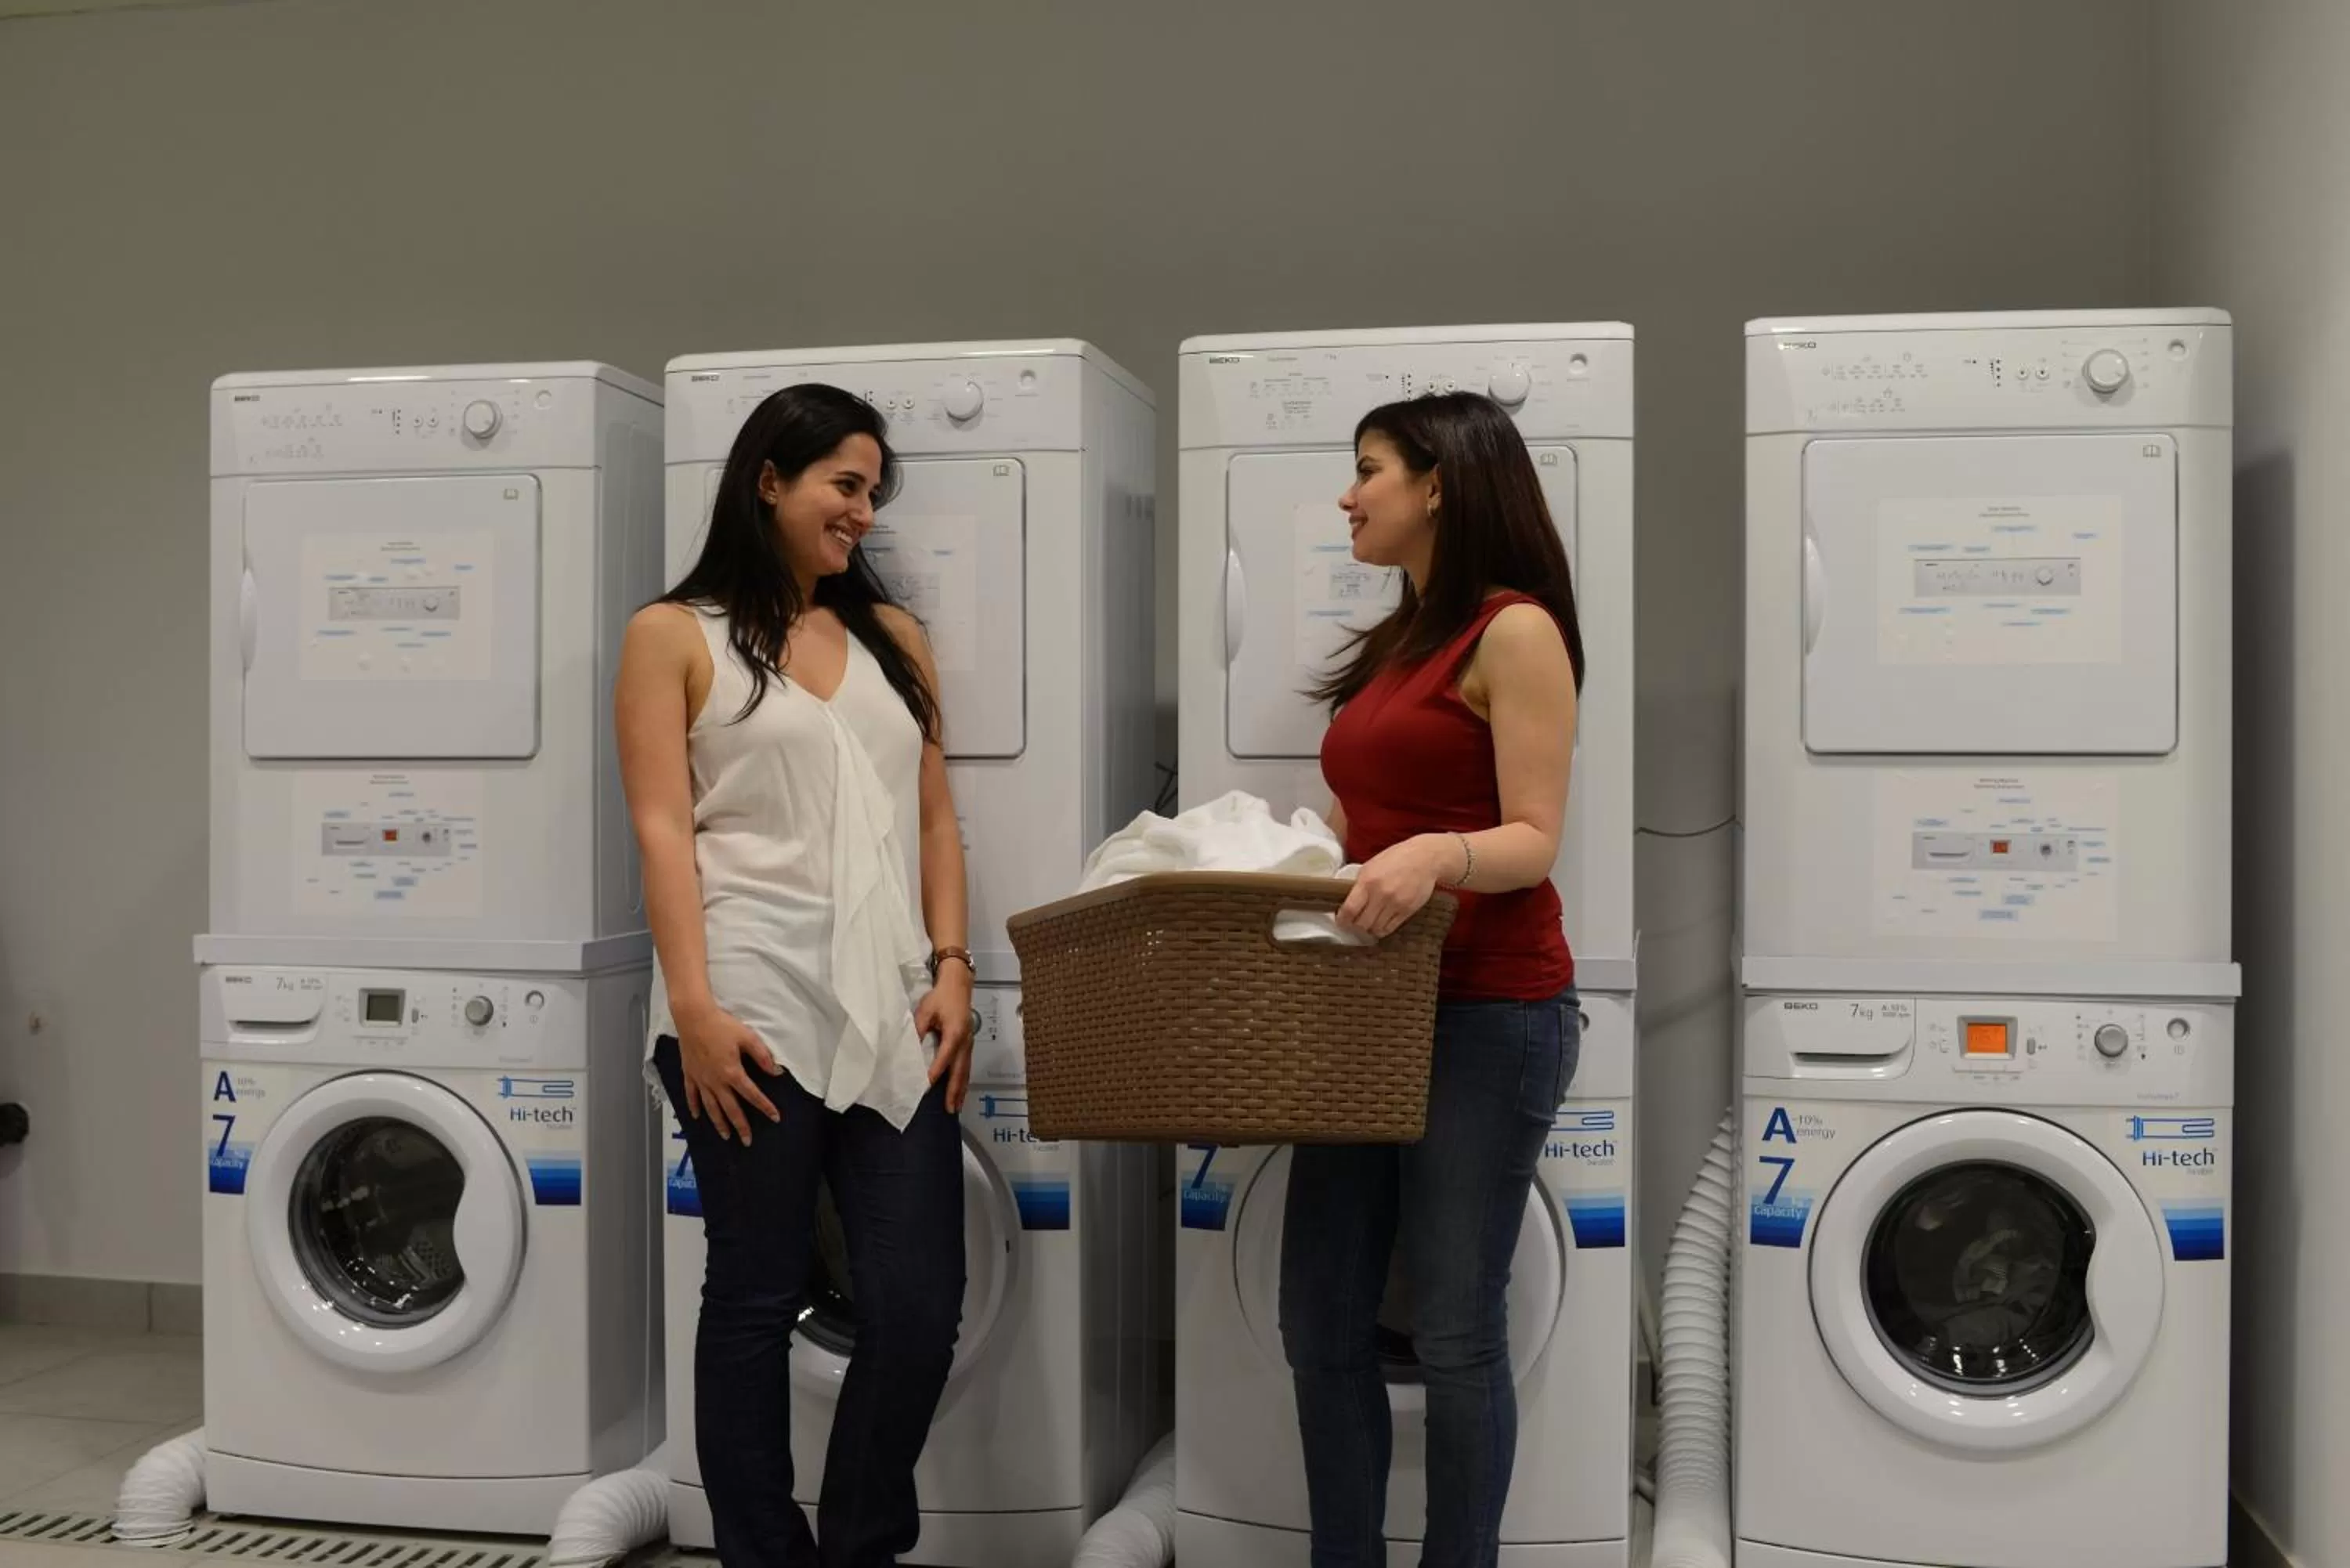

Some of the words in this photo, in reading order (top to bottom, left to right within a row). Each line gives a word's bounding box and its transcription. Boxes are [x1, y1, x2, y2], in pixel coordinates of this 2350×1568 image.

[213, 1071, 237, 1103] A
[510, 1105, 573, 1123] Hi-tech
[1762, 1107, 1797, 1143] A
[212, 1114, 237, 1157] 7
[992, 1127, 1038, 1143] Hi-te
[1545, 1139, 1615, 1158] Hi-tech
[1188, 1143, 1219, 1189] 7
[2142, 1147, 2215, 1166] Hi-tech
[1759, 1155, 1795, 1205] 7
